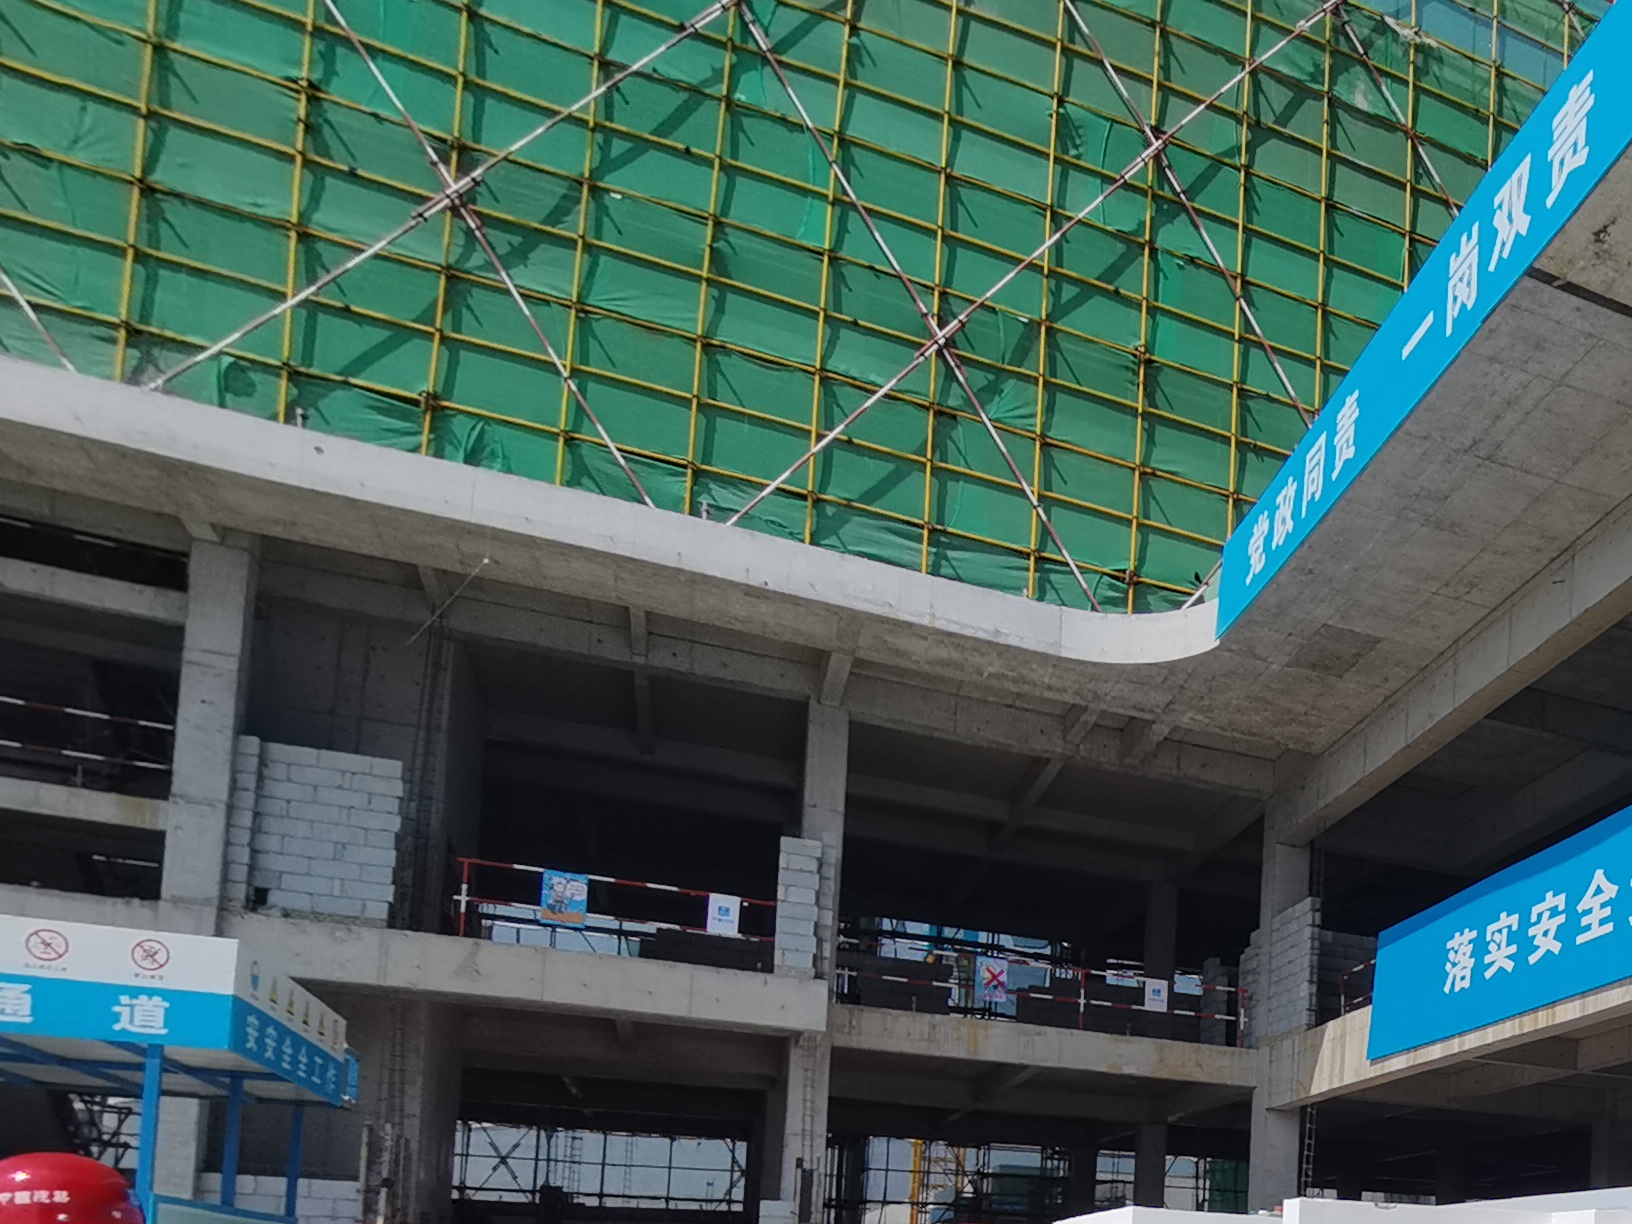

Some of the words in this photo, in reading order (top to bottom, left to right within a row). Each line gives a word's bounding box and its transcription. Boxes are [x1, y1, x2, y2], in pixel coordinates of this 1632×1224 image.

[1246, 390, 1360, 586] 党政同责
[1402, 69, 1596, 361] 一岗双责
